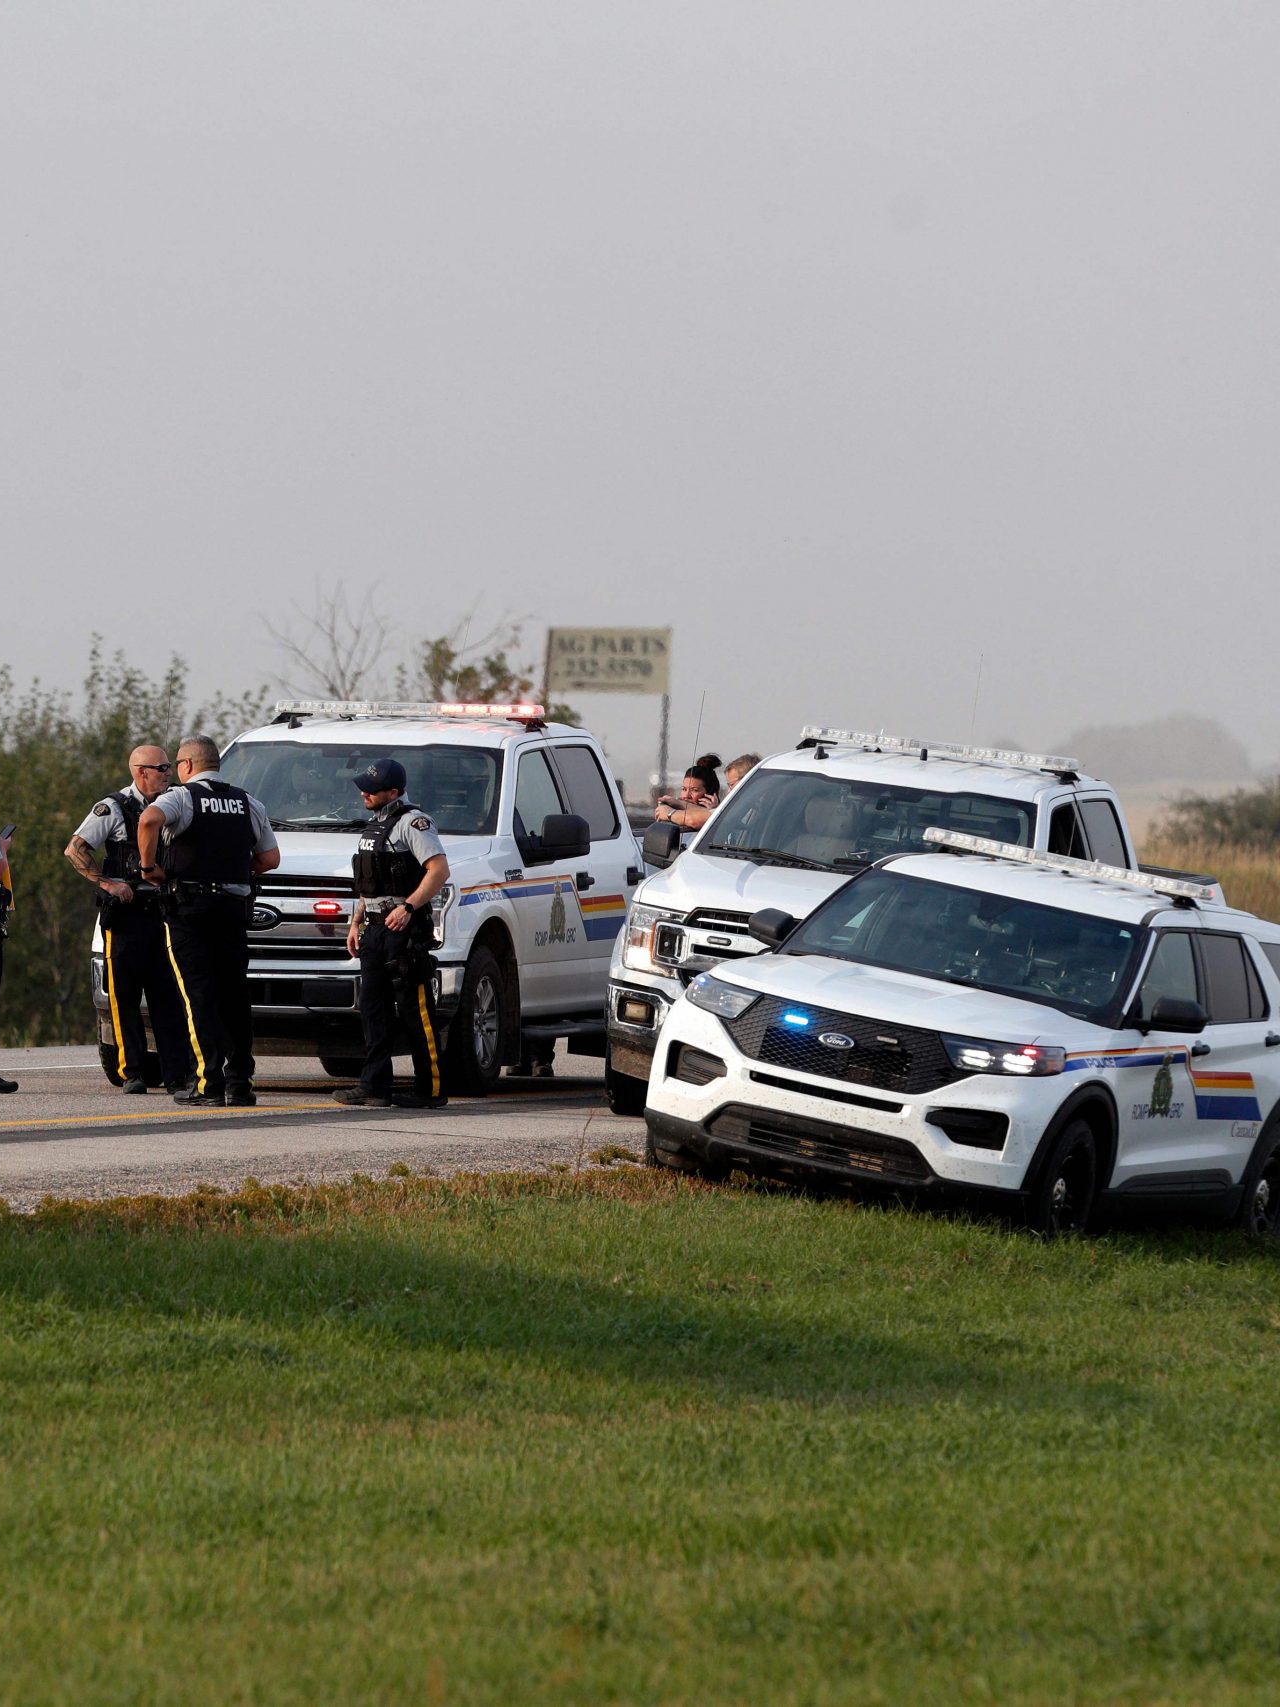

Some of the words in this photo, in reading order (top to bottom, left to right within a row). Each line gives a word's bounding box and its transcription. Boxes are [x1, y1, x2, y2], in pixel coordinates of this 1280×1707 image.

[591, 635, 668, 655] PARTS
[200, 797, 245, 815] POLICE
[479, 889, 503, 903] POLICE
[1086, 1056, 1116, 1069] POLICE
[1131, 1103, 1149, 1120] RCMP
[1231, 1120, 1258, 1139] Canada
